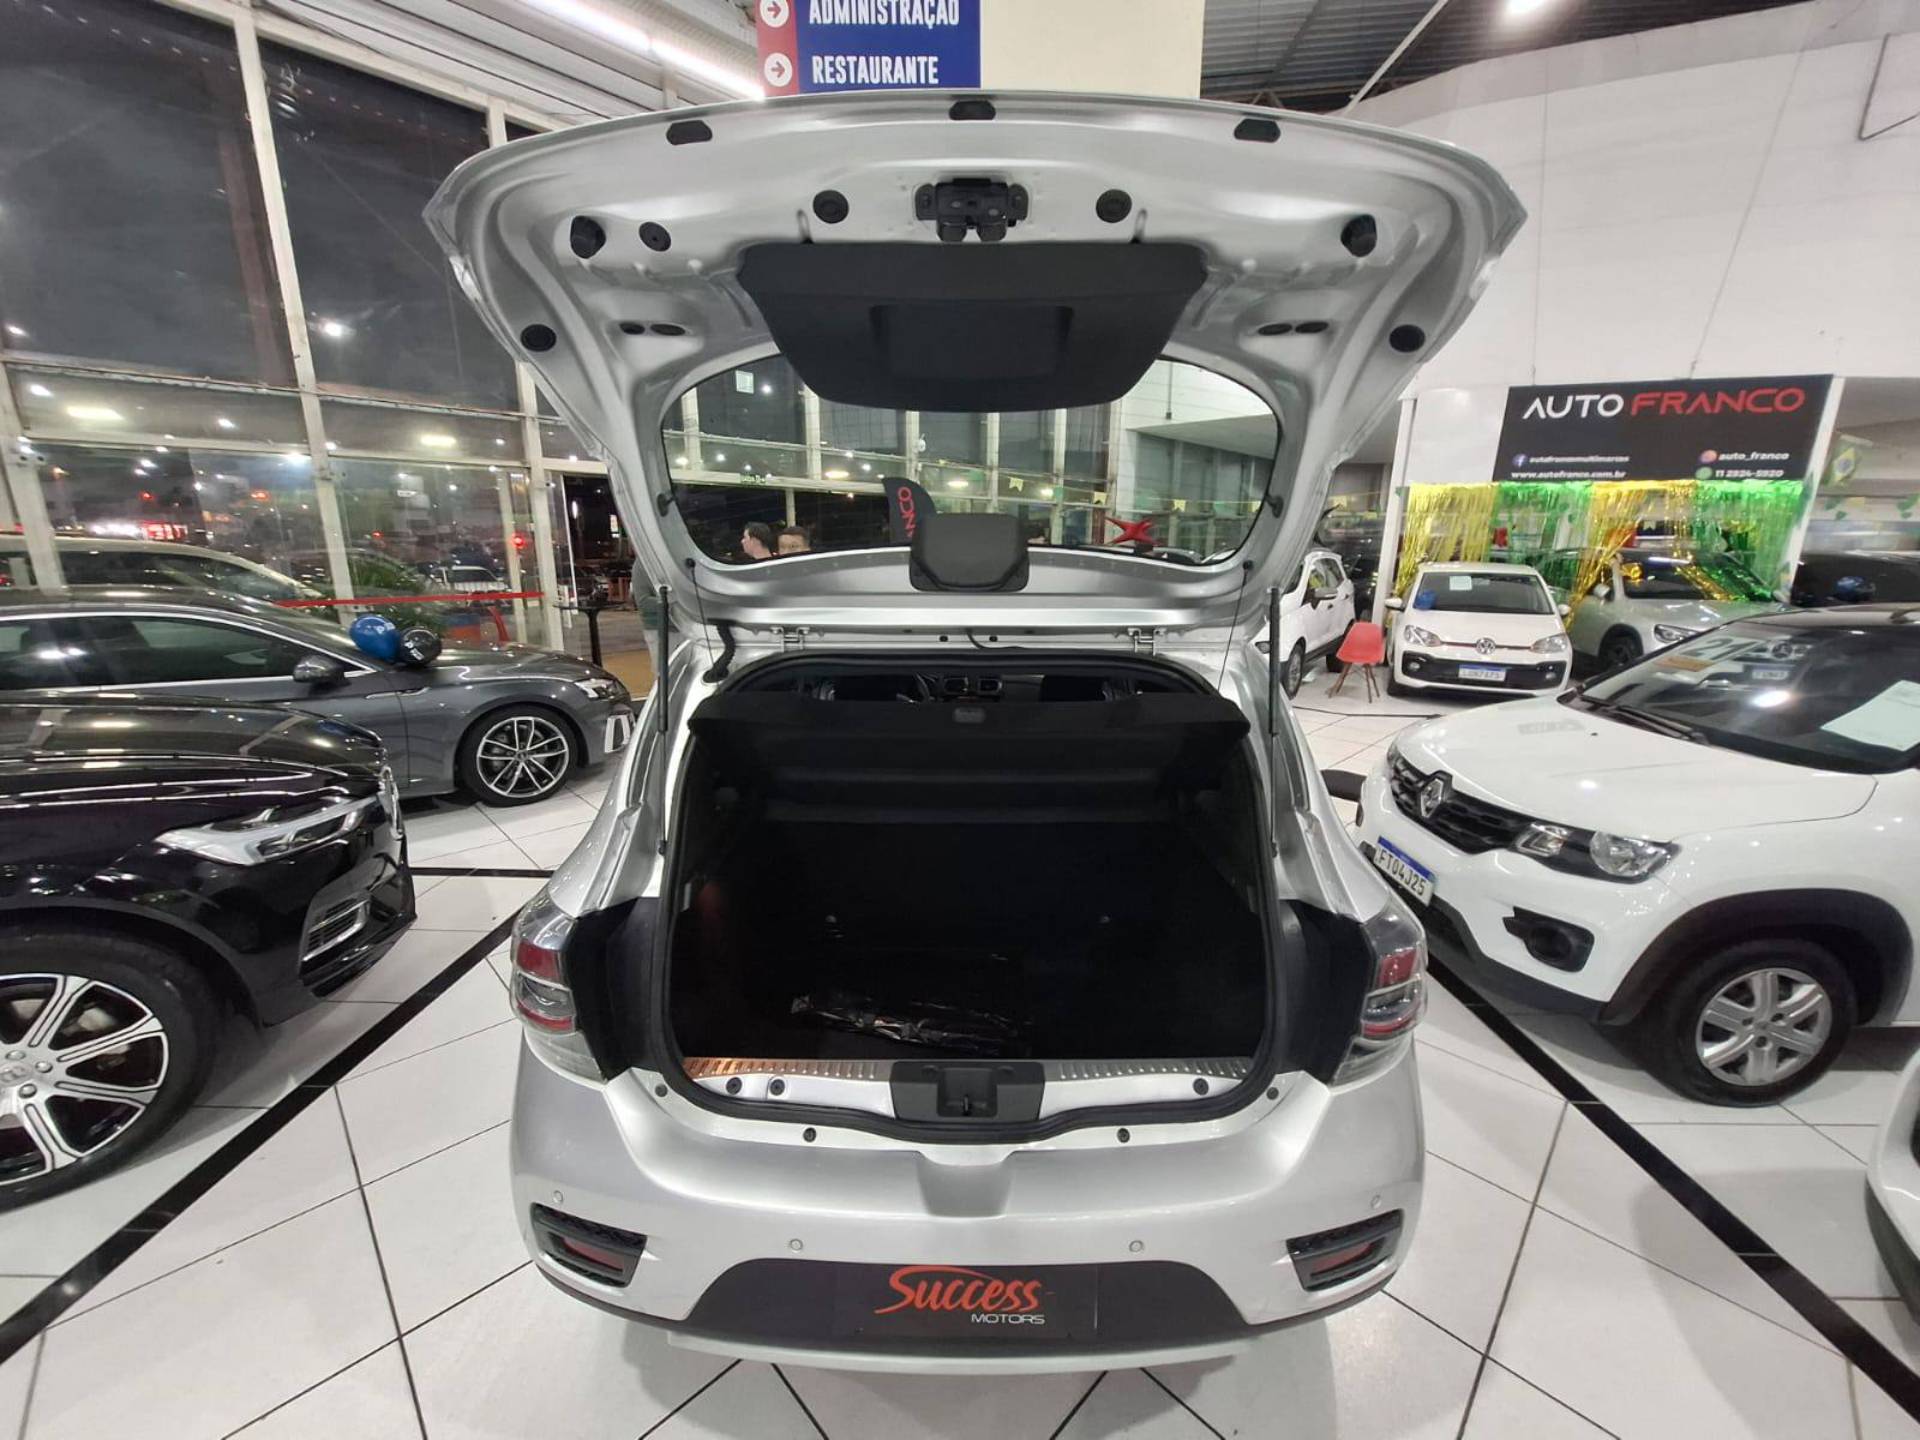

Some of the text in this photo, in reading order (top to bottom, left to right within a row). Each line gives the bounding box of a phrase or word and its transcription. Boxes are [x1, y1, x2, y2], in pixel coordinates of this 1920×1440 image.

[812, 56, 939, 84] RESTAURANTE
[1523, 388, 1805, 419] AUTO FRANCO
[1717, 451, 1790, 461] auto_franco
[970, 1313, 1046, 1325] MOTORS
